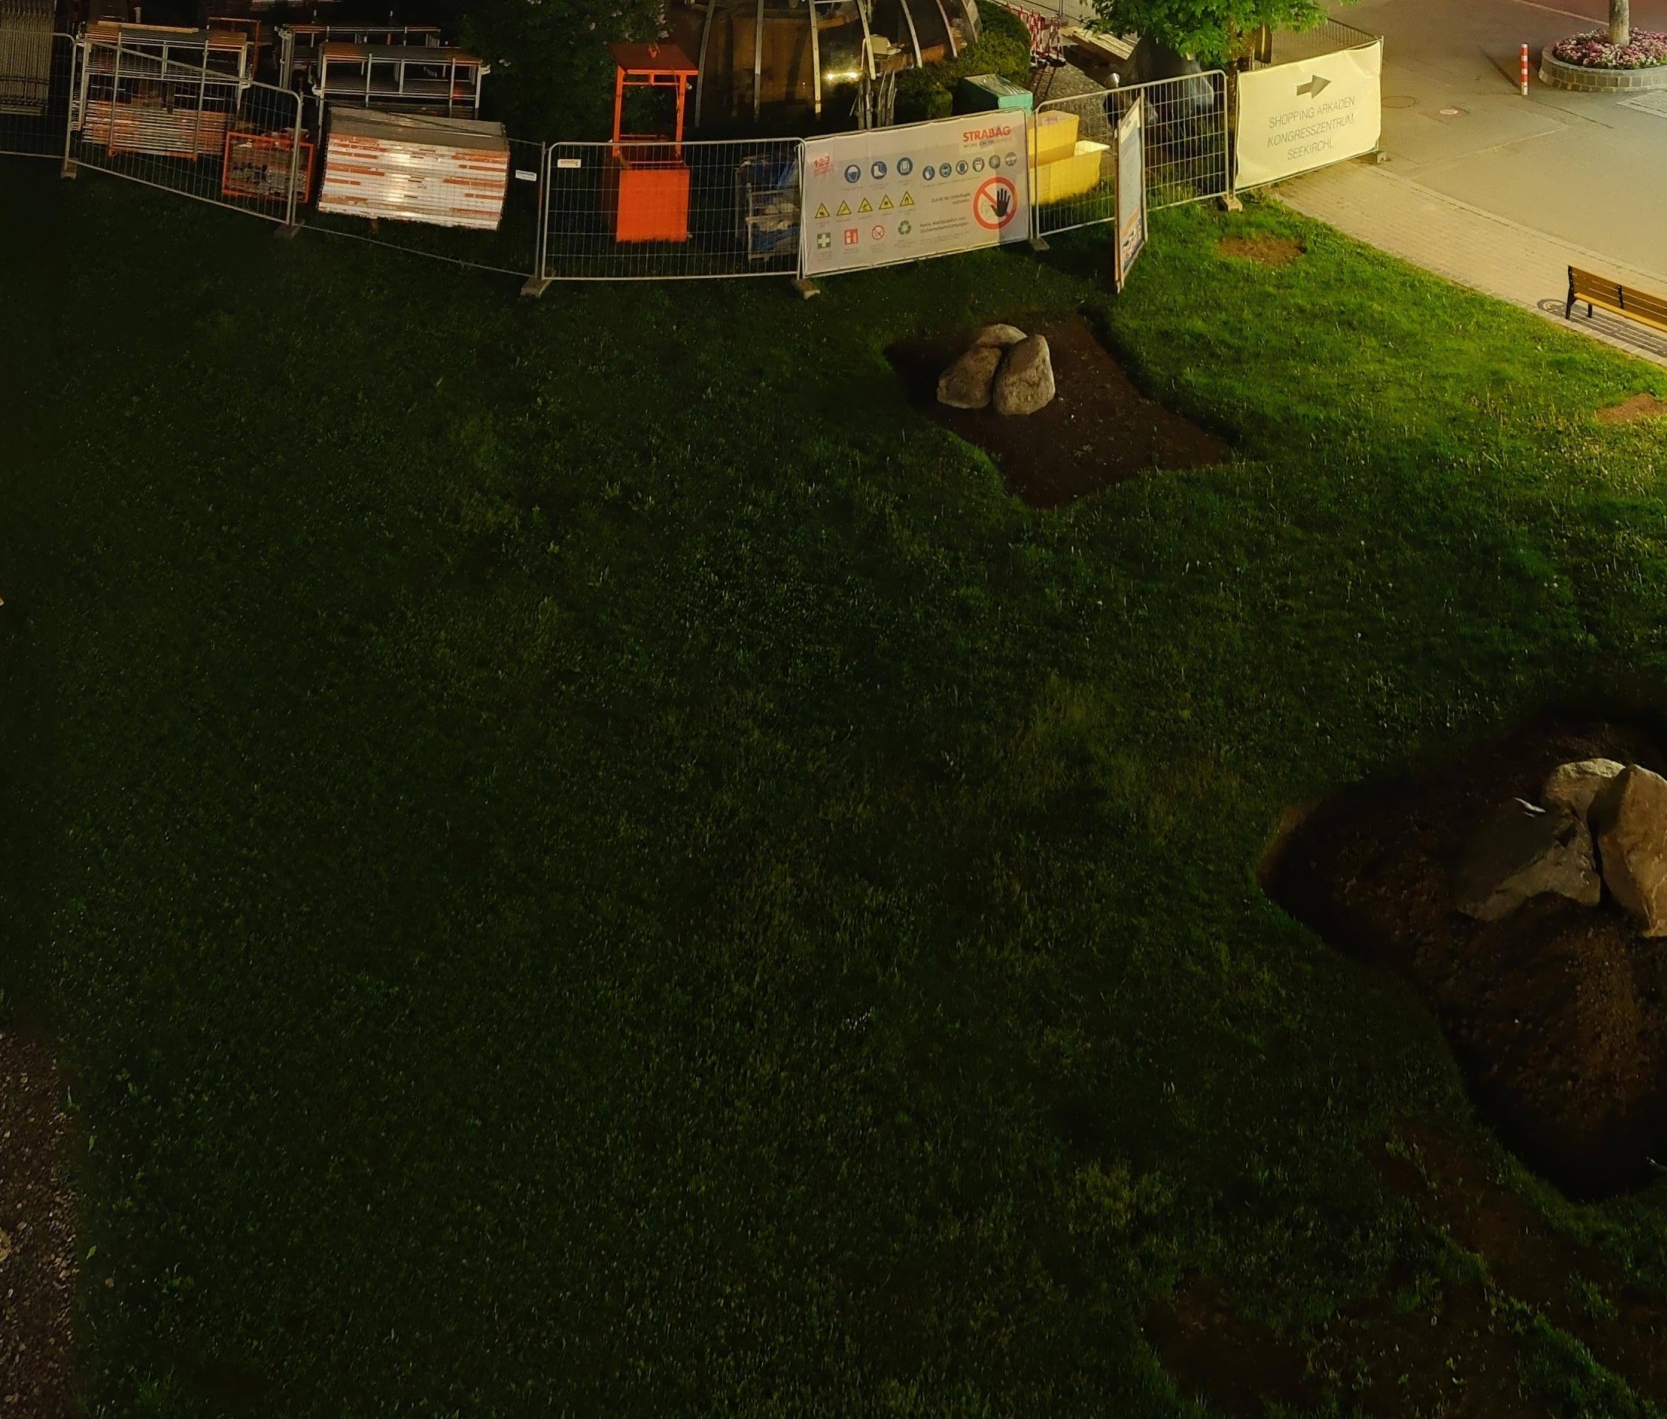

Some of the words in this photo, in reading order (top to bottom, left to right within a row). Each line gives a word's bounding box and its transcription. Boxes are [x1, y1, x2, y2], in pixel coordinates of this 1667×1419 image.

[1268, 107, 1315, 129] SHOPPING
[1317, 96, 1355, 119] ARKADEN
[963, 126, 1011, 142] STRABAG
[1267, 113, 1355, 148] KONGRESSZENTRUM
[1287, 138, 1334, 161] SEEKIRCHL
